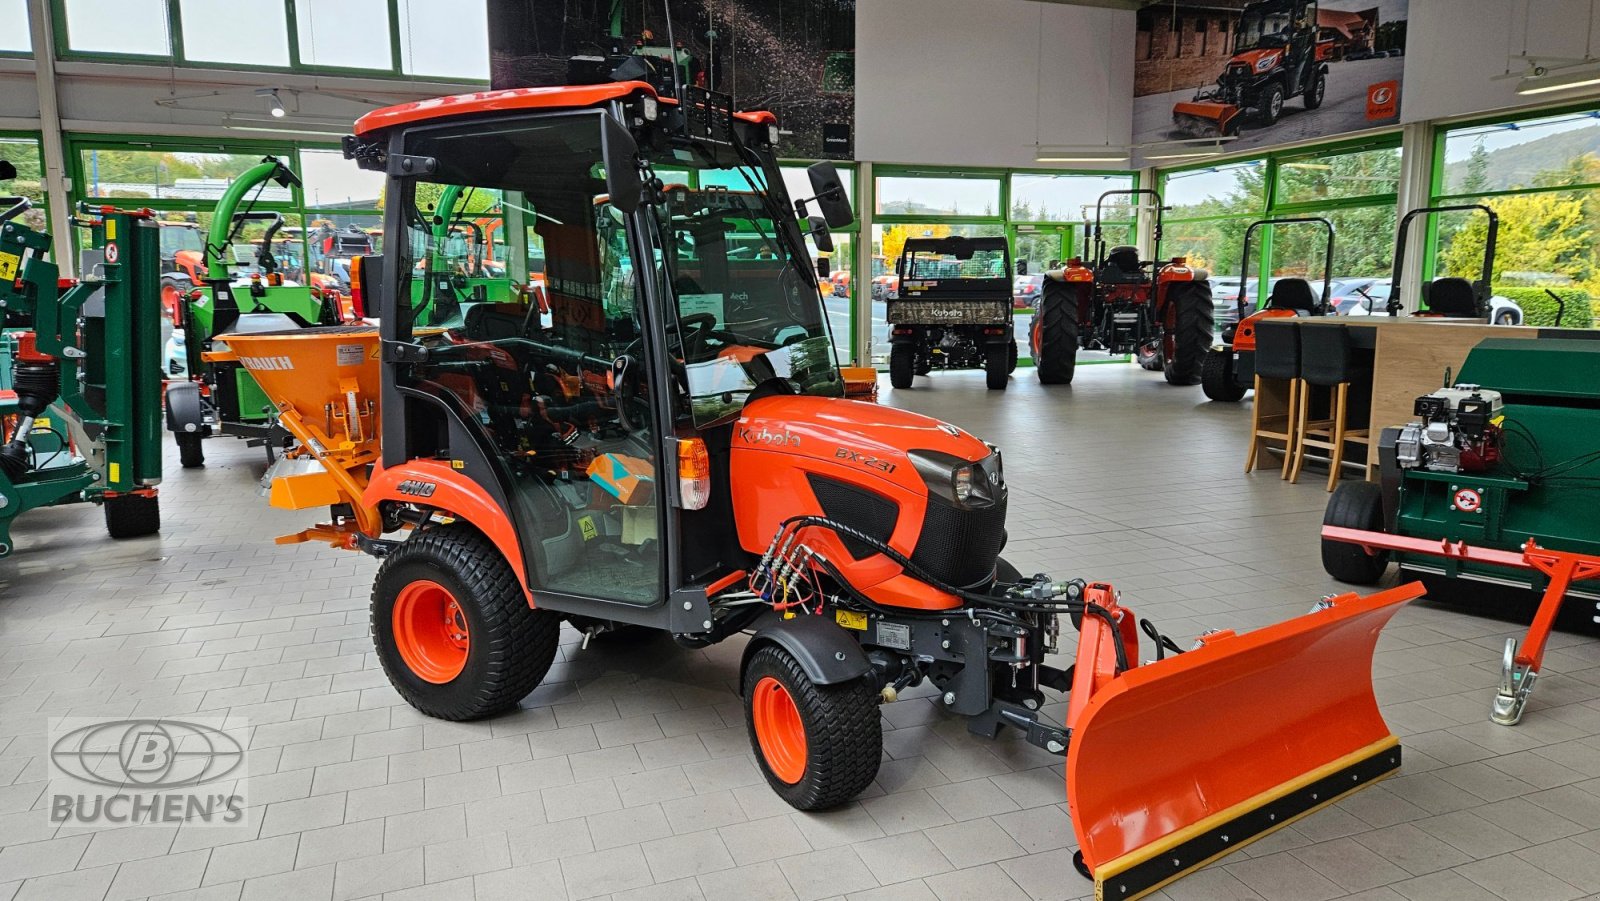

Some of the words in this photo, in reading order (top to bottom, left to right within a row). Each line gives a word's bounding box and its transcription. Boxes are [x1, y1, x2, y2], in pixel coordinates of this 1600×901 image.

[931, 308, 963, 318] Kubota
[738, 427, 801, 447] Kubota
[835, 447, 897, 474] BX-231
[397, 479, 437, 498] 4WD
